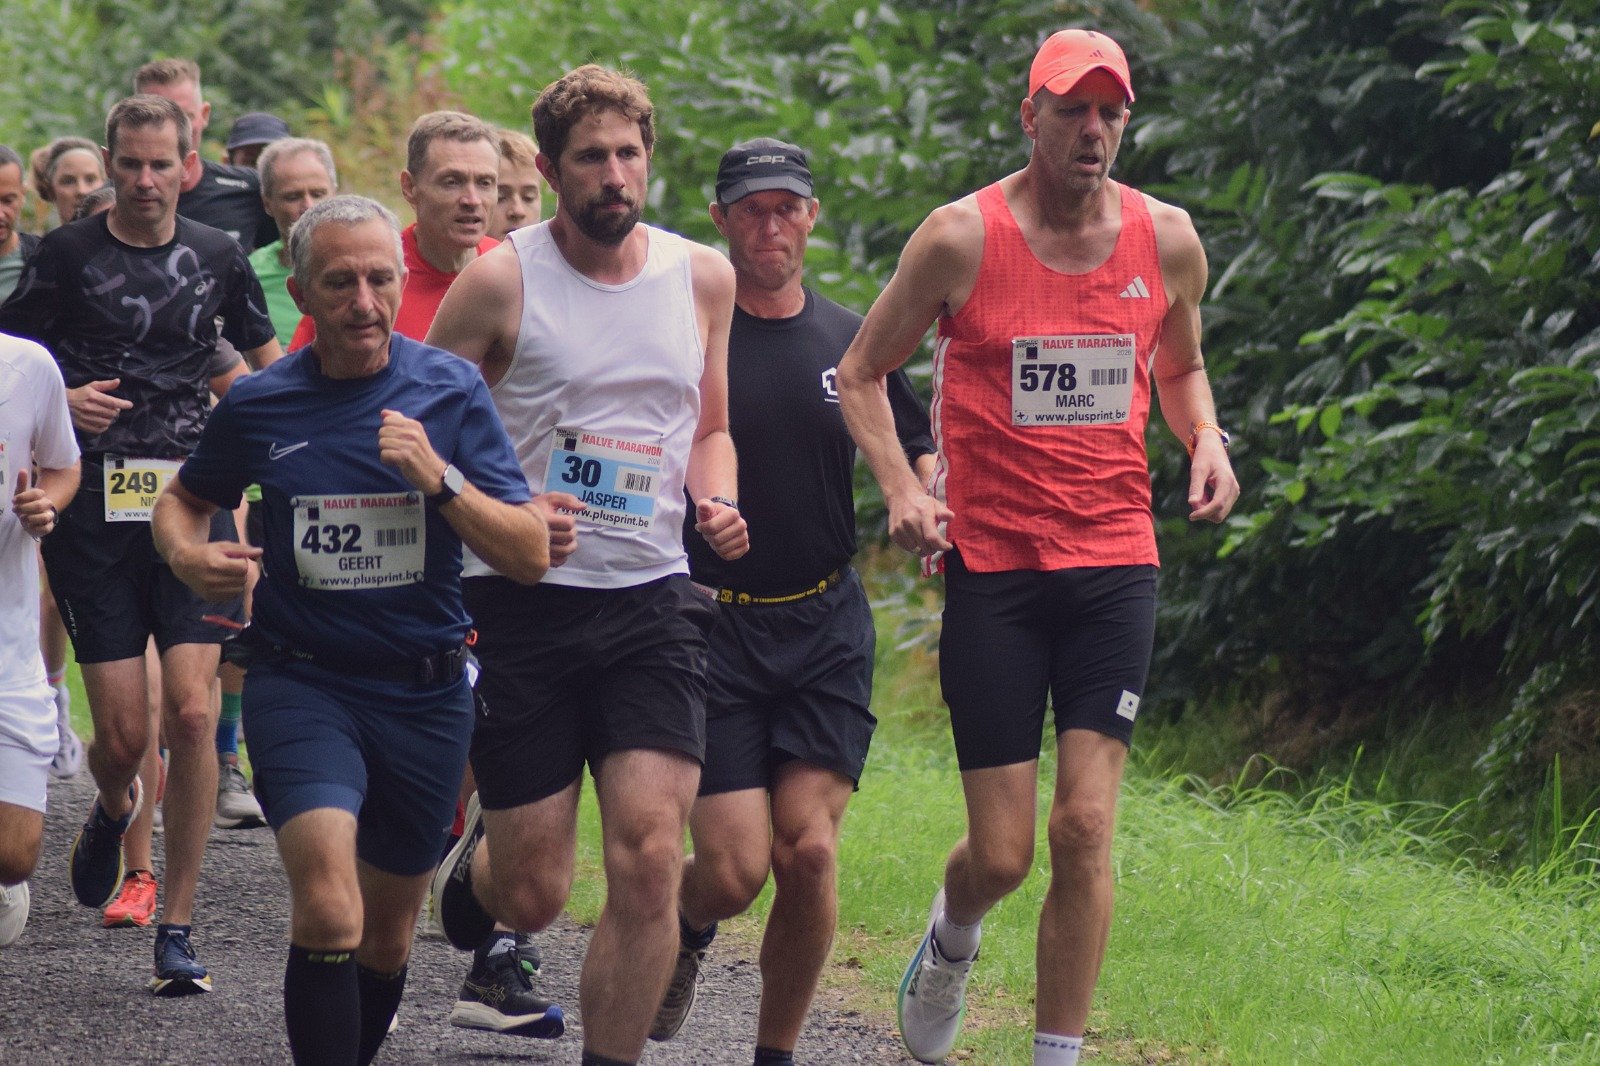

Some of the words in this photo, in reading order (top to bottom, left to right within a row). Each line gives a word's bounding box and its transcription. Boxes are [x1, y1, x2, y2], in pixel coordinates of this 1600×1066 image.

[746, 155, 785, 165] cep
[1042, 339, 1074, 349] HALVE
[1077, 337, 1132, 349] MARATHON
[1020, 363, 1077, 392] 578
[1055, 393, 1095, 408] MARC
[1035, 409, 1126, 423] www.plusprint.be
[581, 434, 614, 449] HALVE
[616, 440, 663, 457] MARATHON
[561, 455, 602, 488] 30
[110, 471, 158, 494] 249
[323, 498, 357, 509] HALVE
[578, 490, 627, 510] JASPER
[301, 523, 362, 554] 432
[338, 555, 383, 571] GEERT
